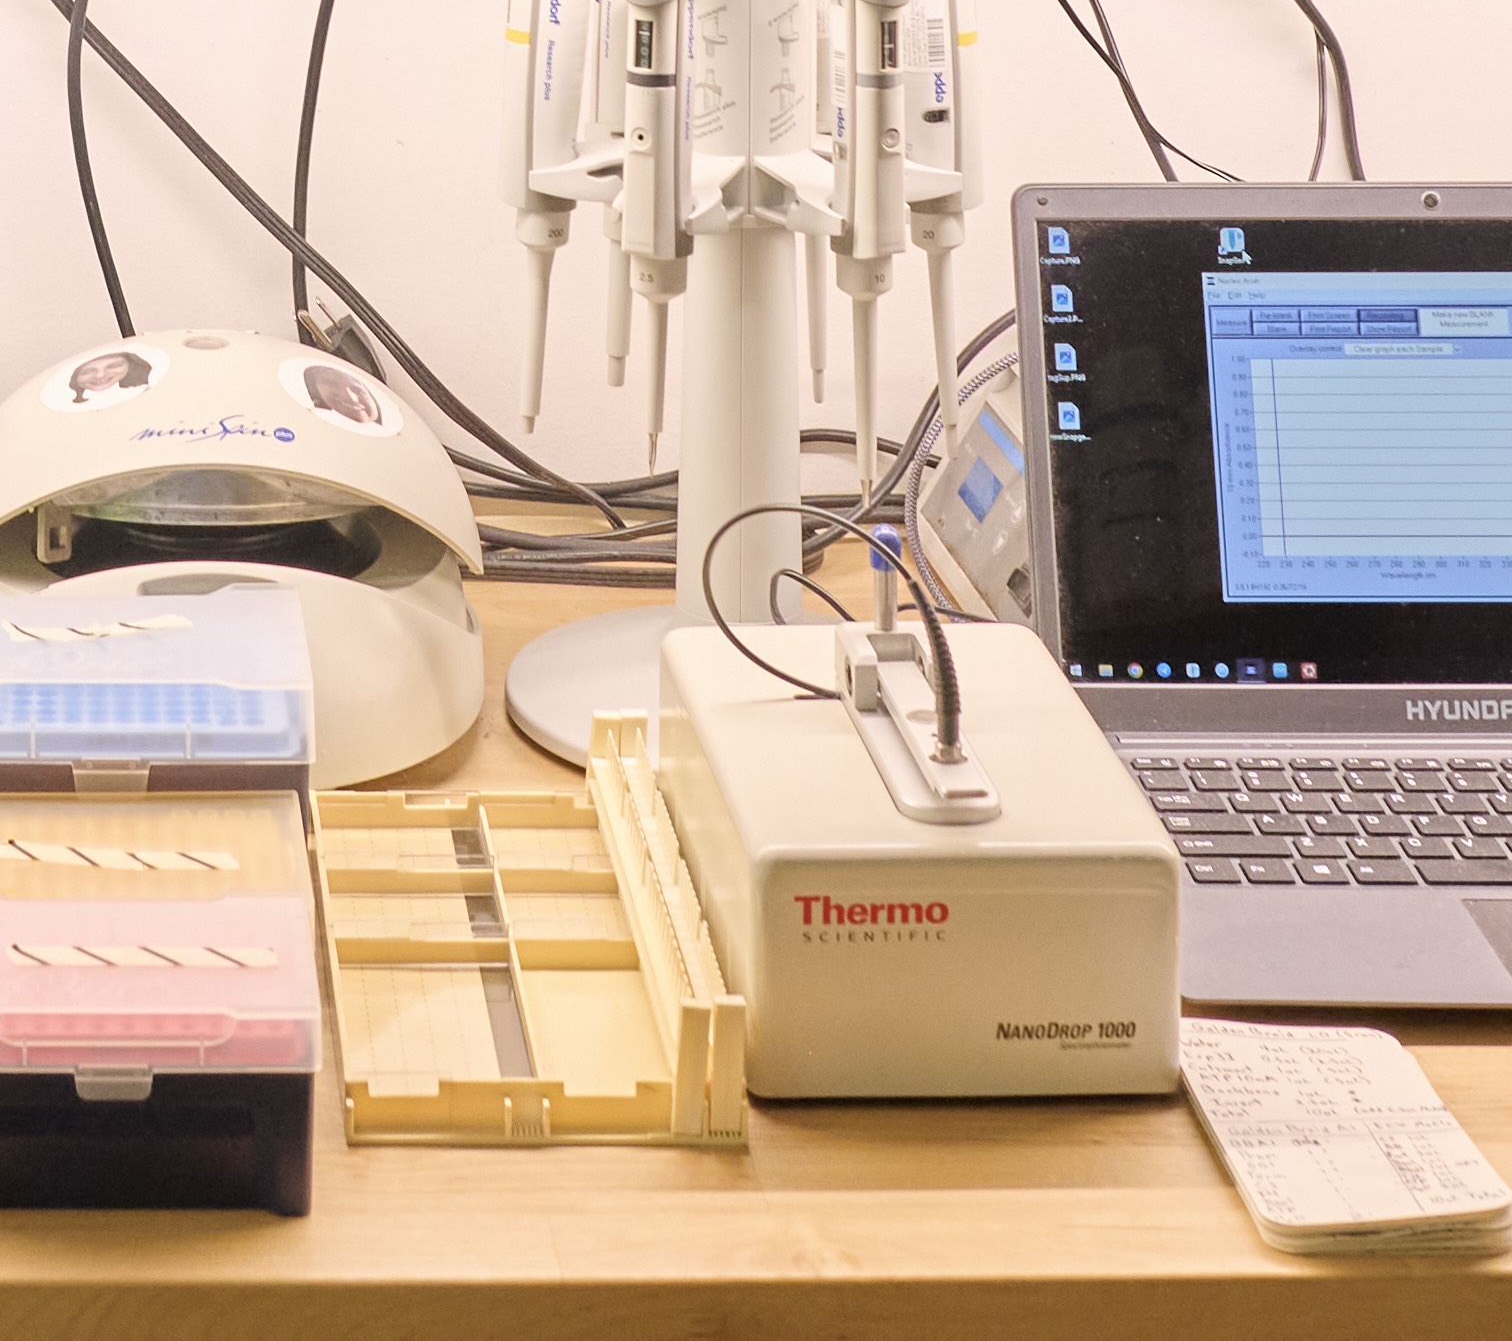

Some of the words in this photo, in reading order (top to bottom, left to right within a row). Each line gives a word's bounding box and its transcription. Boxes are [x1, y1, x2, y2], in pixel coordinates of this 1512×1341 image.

[547, 40, 555, 84] Research
[549, 228, 564, 239] 200
[922, 230, 934, 240] 20
[639, 272, 654, 284] 2.5
[874, 274, 885, 284] 10
[794, 896, 949, 925] Thermo
[803, 930, 946, 943] SCIENTIFIC
[1098, 1021, 1136, 1039] 1000
